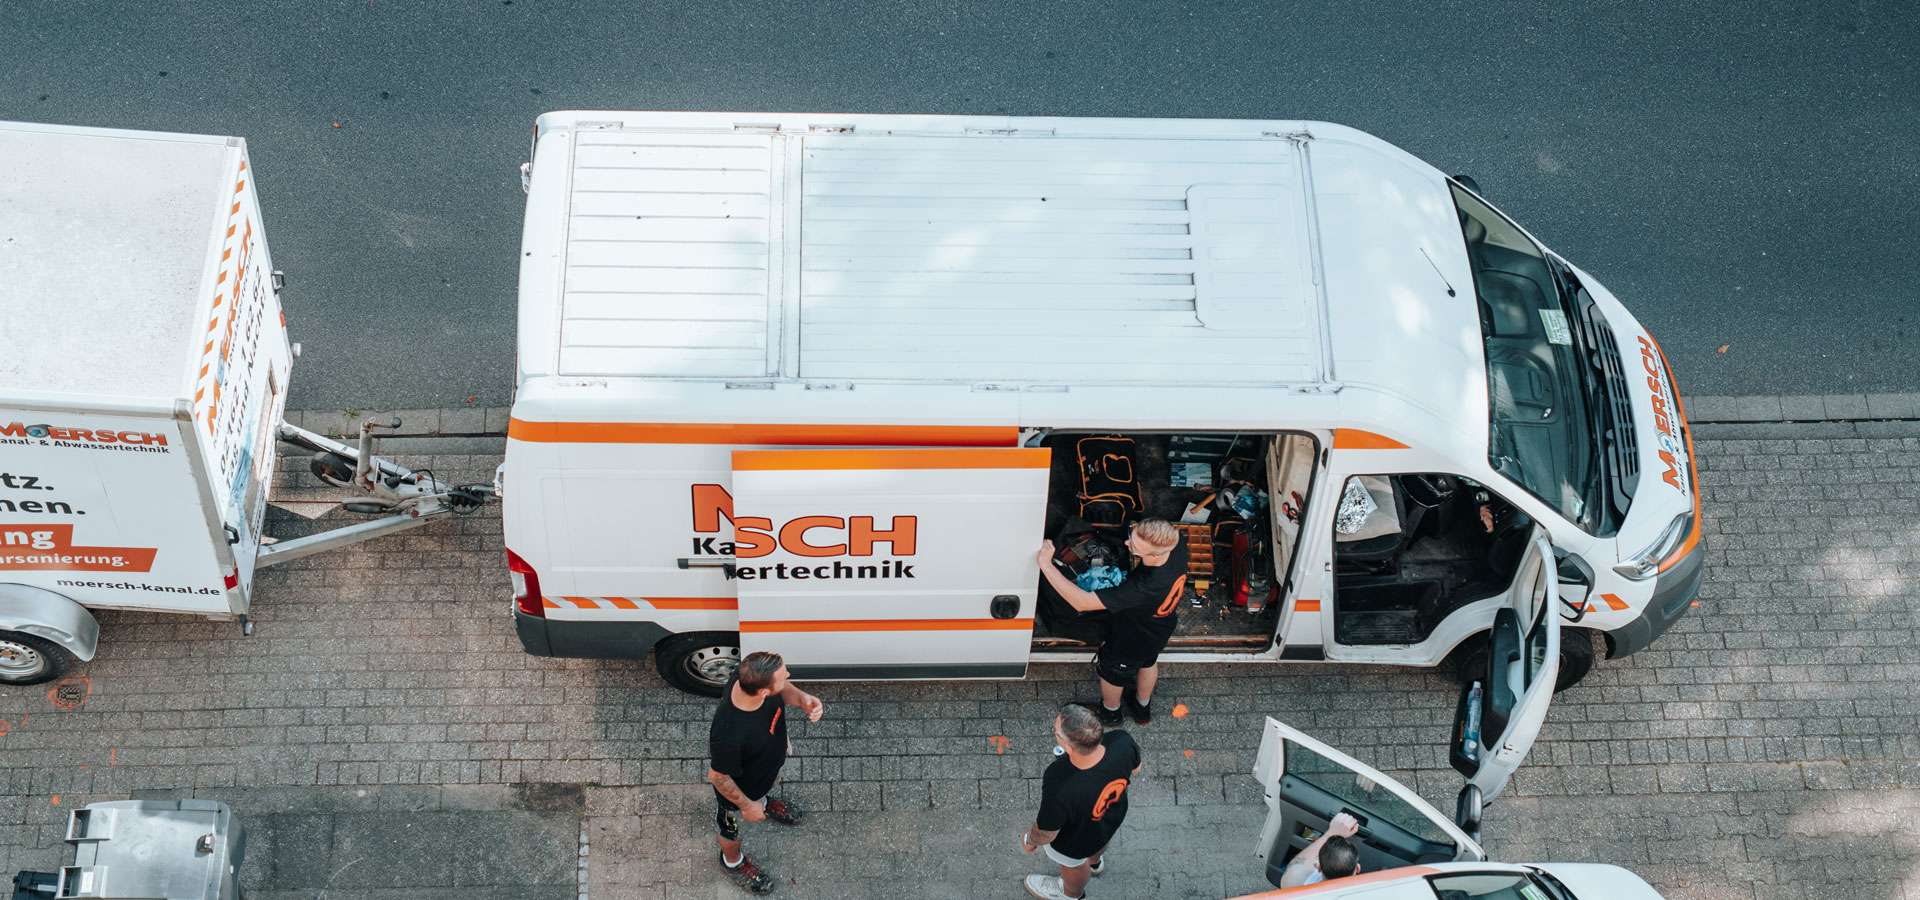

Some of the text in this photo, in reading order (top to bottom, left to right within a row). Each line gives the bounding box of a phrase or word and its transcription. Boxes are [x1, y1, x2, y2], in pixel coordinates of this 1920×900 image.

[54, 440, 170, 454] Abwassertechnik
[0, 531, 56, 550] ng
[693, 537, 736, 555] Ka
[733, 516, 917, 558] SCH
[736, 560, 915, 580] ertechnik
[57, 579, 220, 596] moersch-kanal.de
